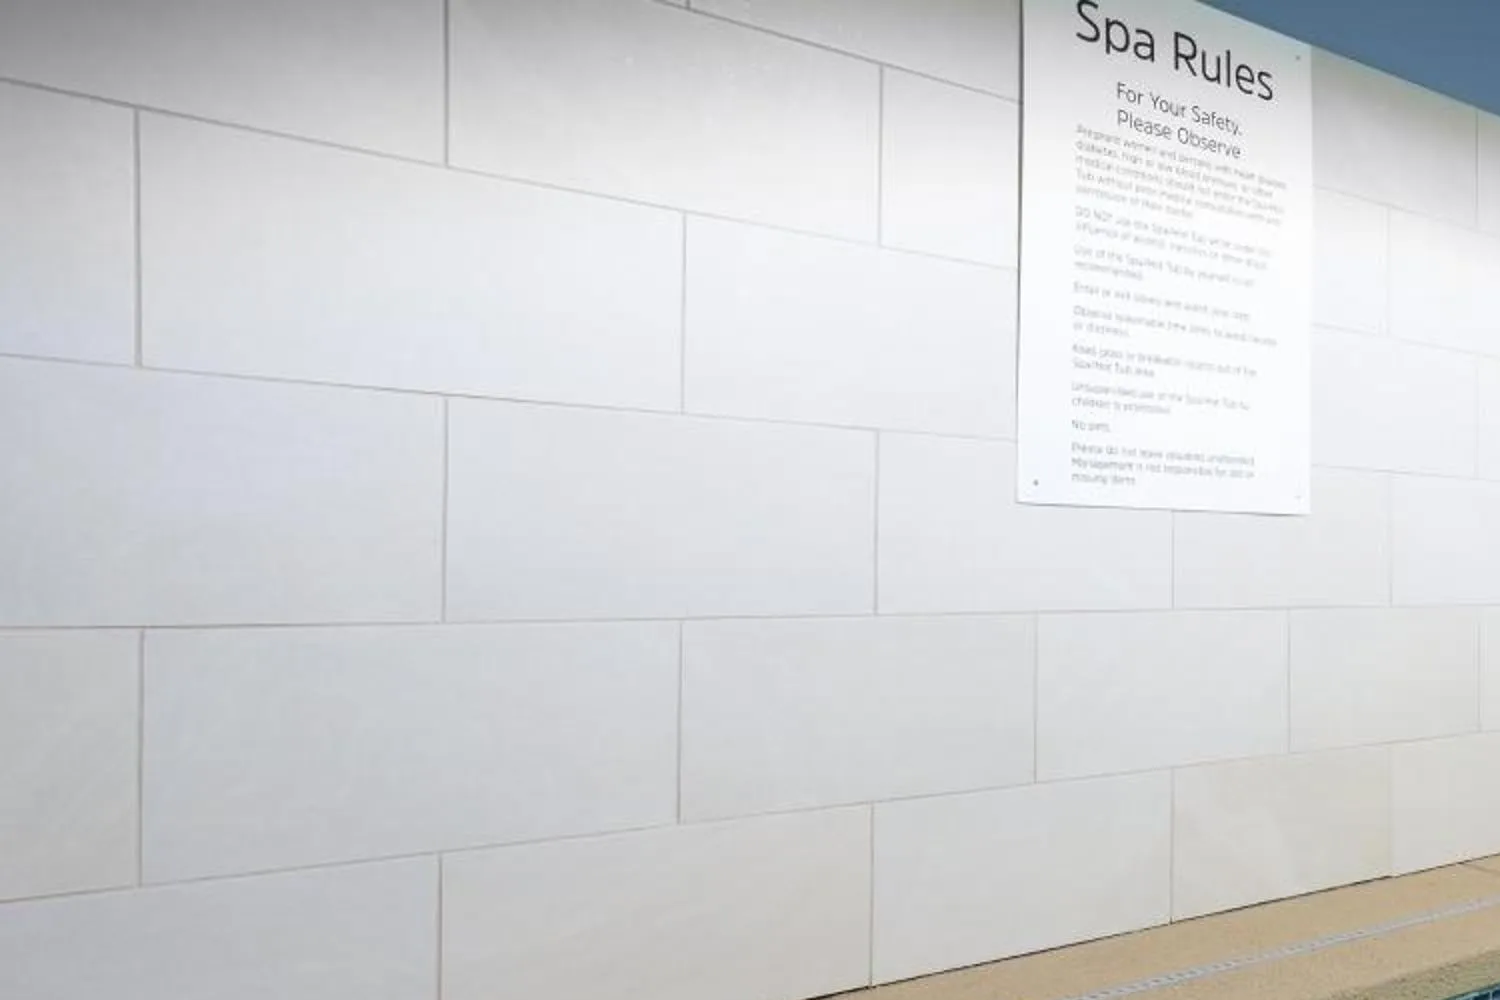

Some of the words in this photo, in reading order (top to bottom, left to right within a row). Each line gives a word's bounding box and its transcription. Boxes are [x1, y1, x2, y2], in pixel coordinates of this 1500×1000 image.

[1076, 0, 1156, 62] Spa
[1174, 31, 1274, 101] Rules
[1117, 82, 1144, 105] For
[1150, 91, 1186, 118] Your
[1117, 109, 1172, 141] Please
[1177, 127, 1242, 159] Observe
